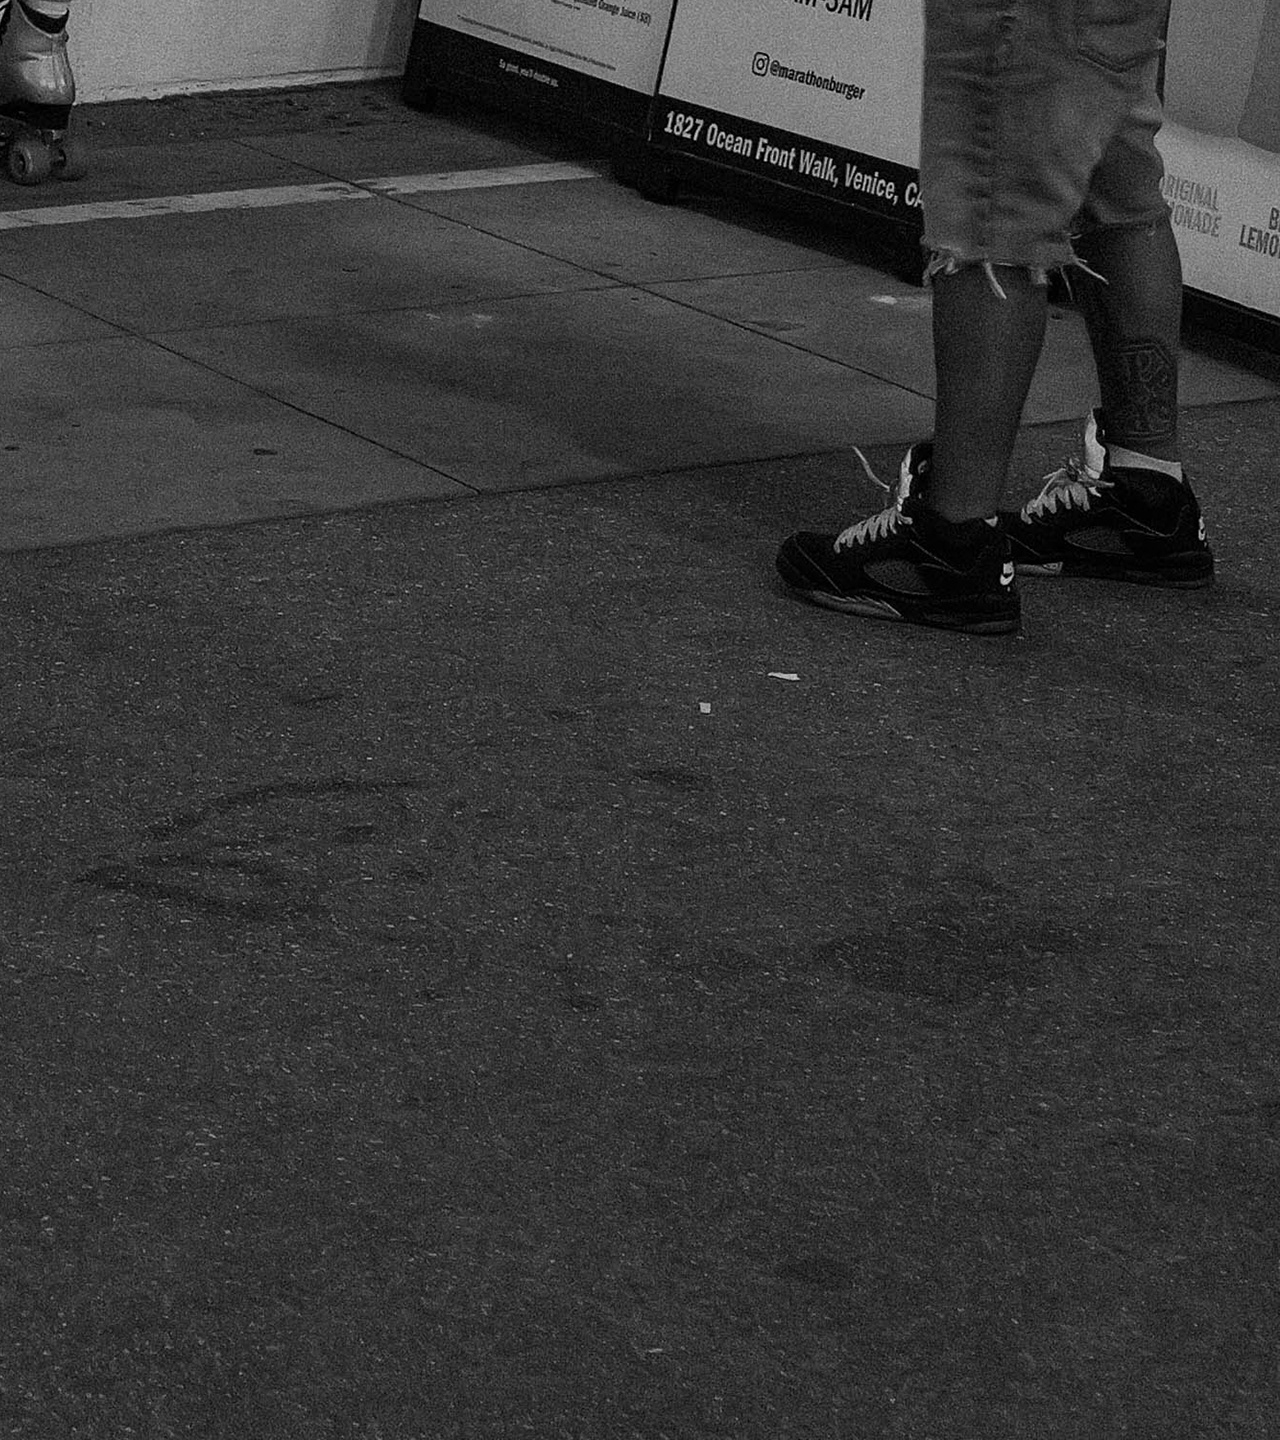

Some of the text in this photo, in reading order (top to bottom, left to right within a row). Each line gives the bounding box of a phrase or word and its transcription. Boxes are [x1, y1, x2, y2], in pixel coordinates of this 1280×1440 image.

[769, 60, 866, 100] @marathonburger
[664, 110, 704, 142] 1827
[706, 123, 752, 158] Ocean
[755, 137, 797, 170] Front
[798, 149, 839, 188] Walk,
[845, 163, 899, 206] Venice,
[1239, 225, 1280, 257] LEMO
